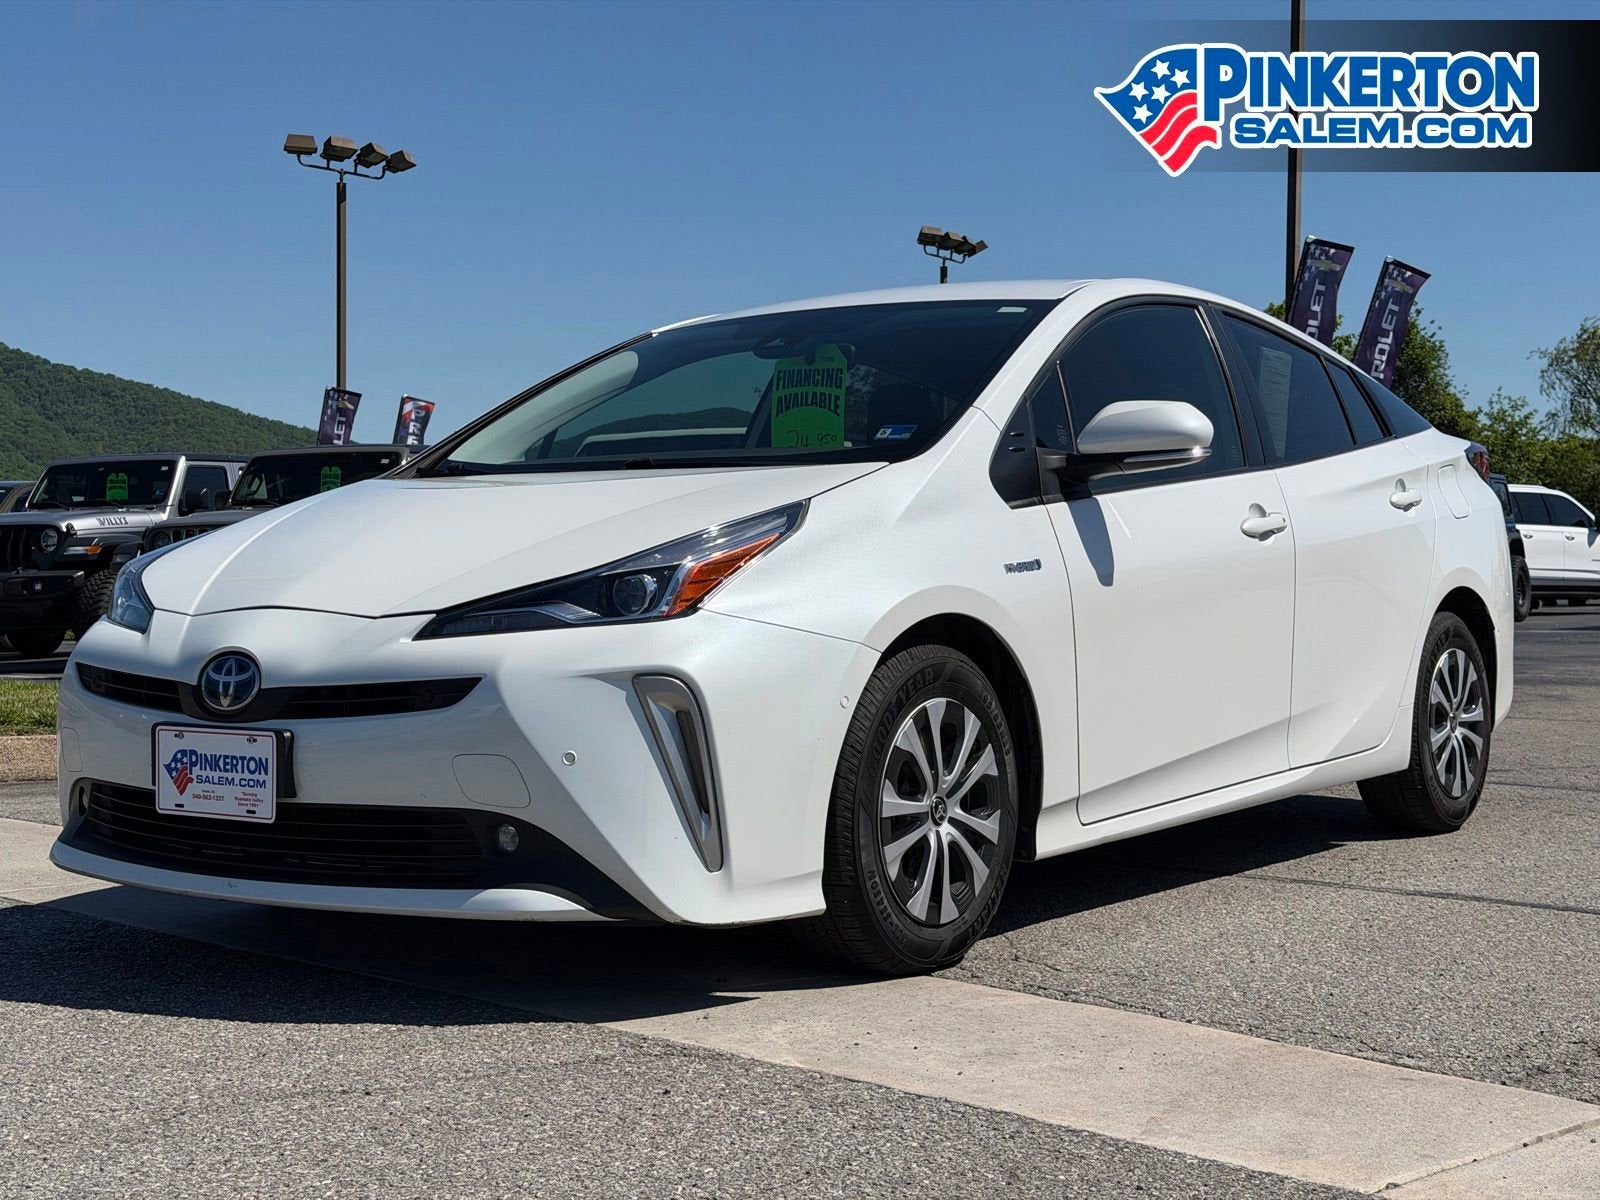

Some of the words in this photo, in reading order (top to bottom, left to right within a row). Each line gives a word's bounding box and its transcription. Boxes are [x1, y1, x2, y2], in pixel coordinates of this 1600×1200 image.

[775, 367, 844, 392] FINANCING
[775, 391, 841, 418] AVAILABLE
[96, 516, 129, 527] WILLYS
[188, 748, 269, 777] PINKERTON
[195, 774, 267, 789] SALEM.COM
